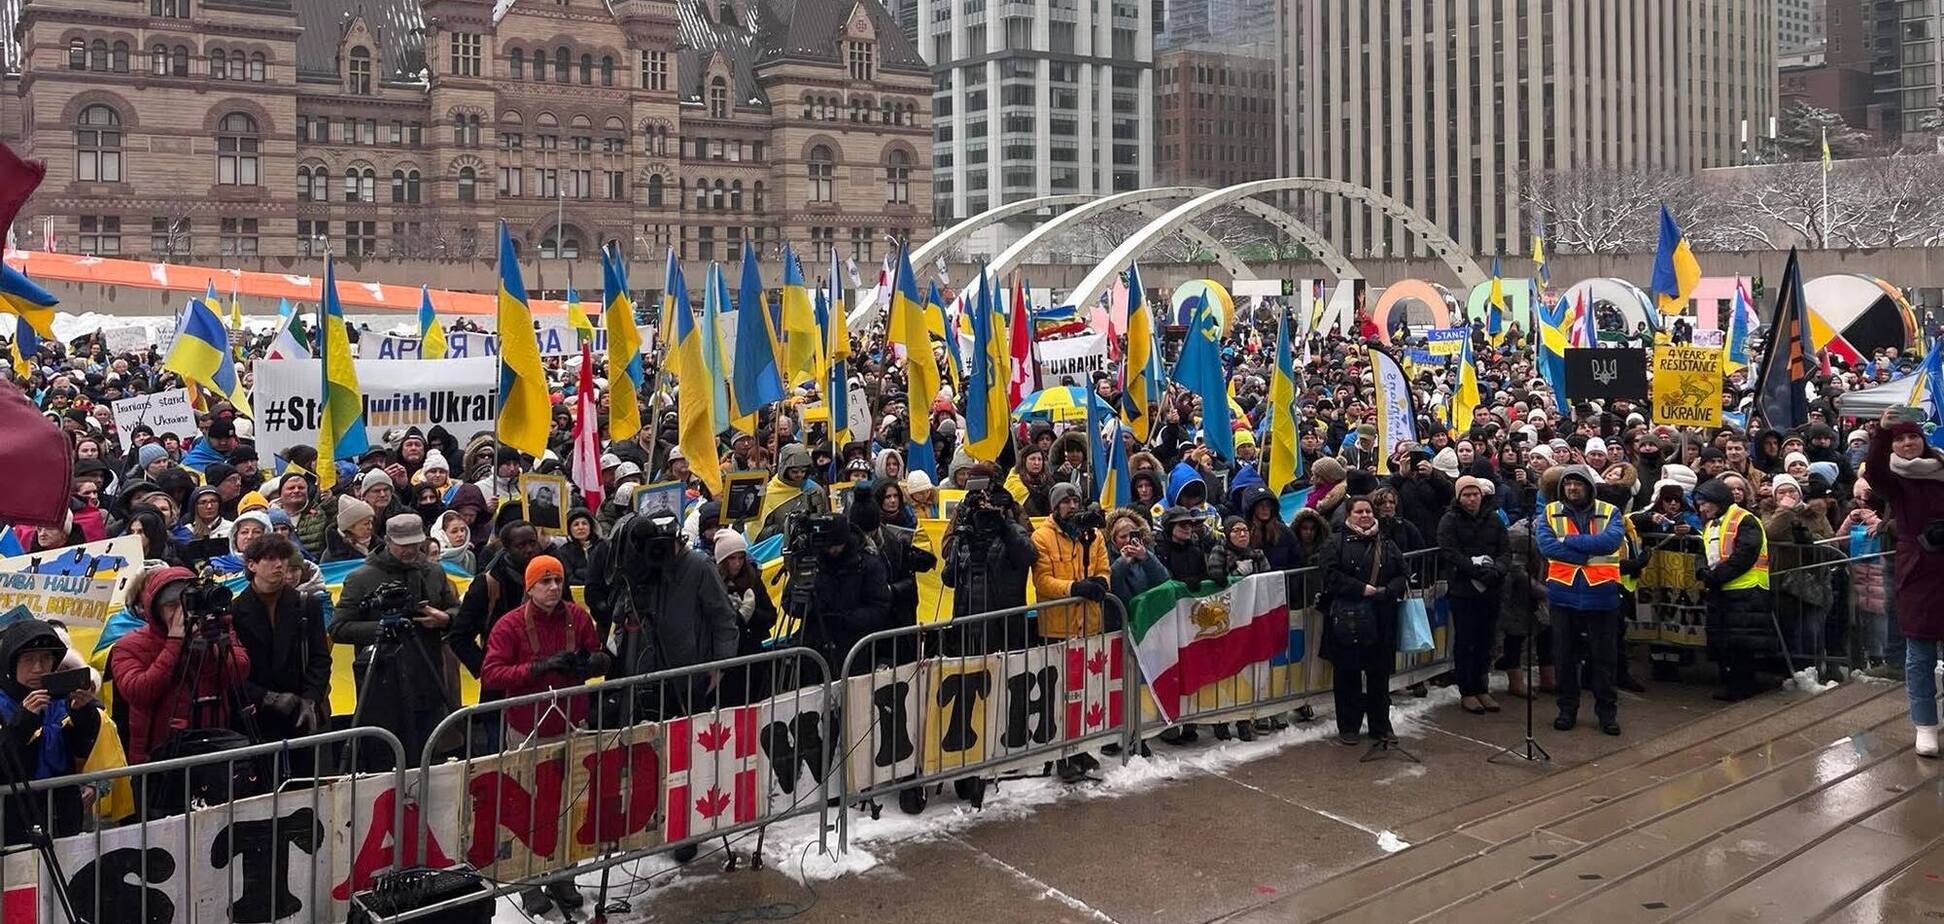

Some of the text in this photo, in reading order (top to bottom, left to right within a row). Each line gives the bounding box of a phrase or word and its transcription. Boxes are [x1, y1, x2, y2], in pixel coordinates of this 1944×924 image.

[1668, 350, 1675, 358] 4
[1678, 350, 1706, 360] YEARS
[1660, 359, 1717, 373] RESISTANCE
[116, 391, 185, 413] Iranians stand
[1661, 406, 1713, 421] UKRAINE
[153, 416, 188, 426] Ukraine
[67, 665, 1058, 924] STAND WITH
